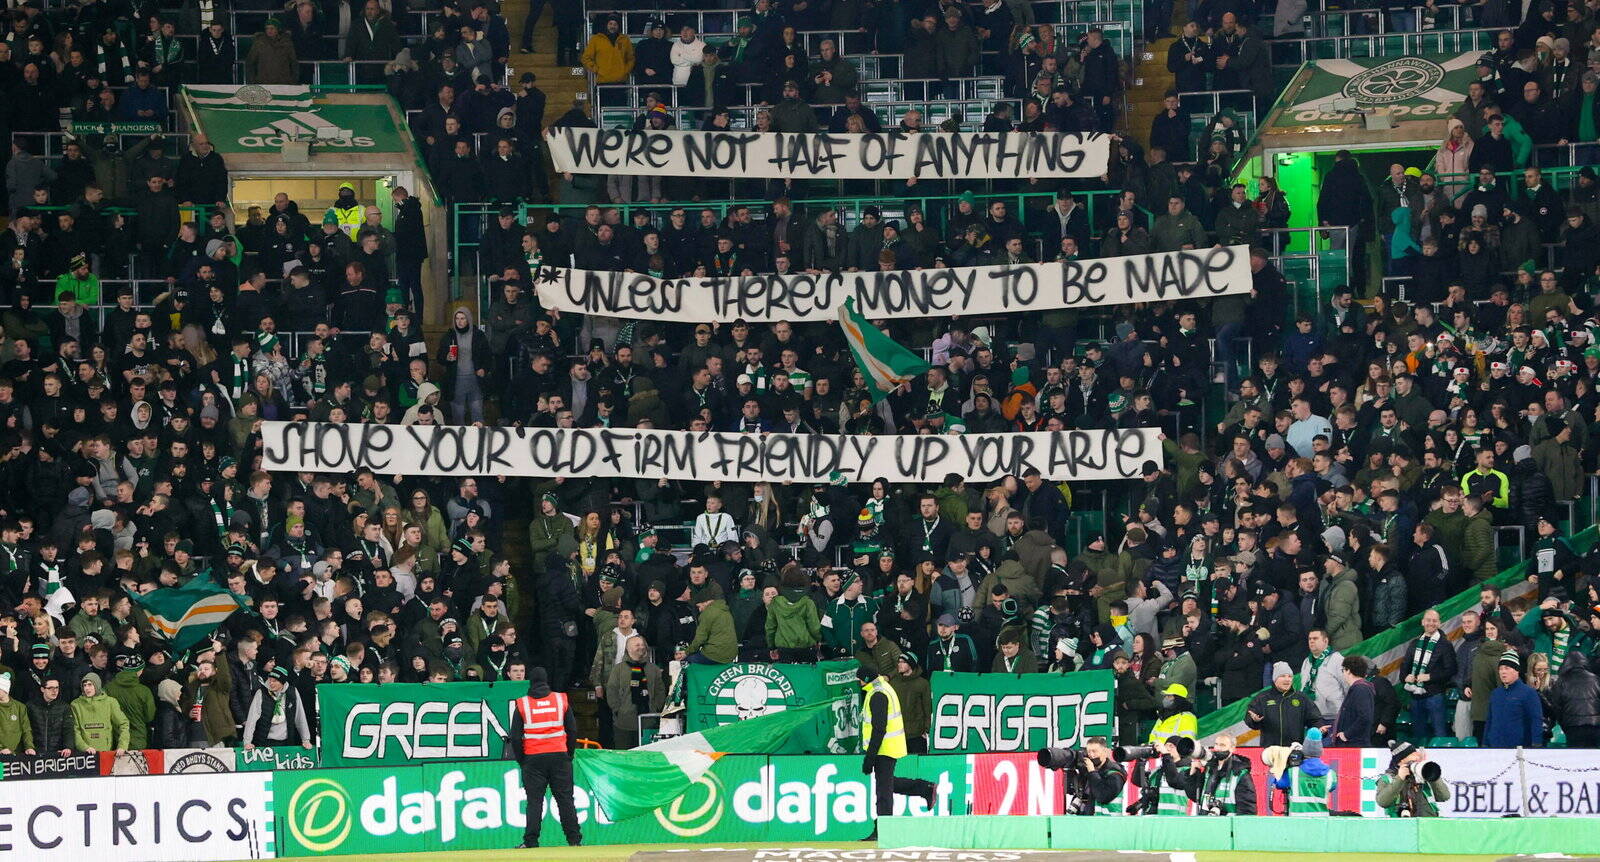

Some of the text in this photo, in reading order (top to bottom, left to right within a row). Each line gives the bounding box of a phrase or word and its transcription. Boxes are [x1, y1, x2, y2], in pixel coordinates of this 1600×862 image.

[682, 132, 760, 173] NOT
[768, 131, 850, 175] HALF
[858, 131, 907, 175] OF
[988, 264, 1039, 309] TO
[406, 423, 514, 474] YOUR
[896, 435, 950, 480] UP
[961, 434, 1035, 479] YOUR
[708, 664, 795, 698] GREEN BRIGADE
[342, 698, 518, 760] GREEN
[933, 690, 1109, 751] BRIGADE
[35, 755, 96, 774] BRIGADE
[241, 747, 314, 769] the kids
[1450, 781, 1520, 813] BELL
[1527, 784, 1549, 813] &
[0, 797, 249, 851] ECTRICS
[753, 850, 1023, 860] MAGNERS
